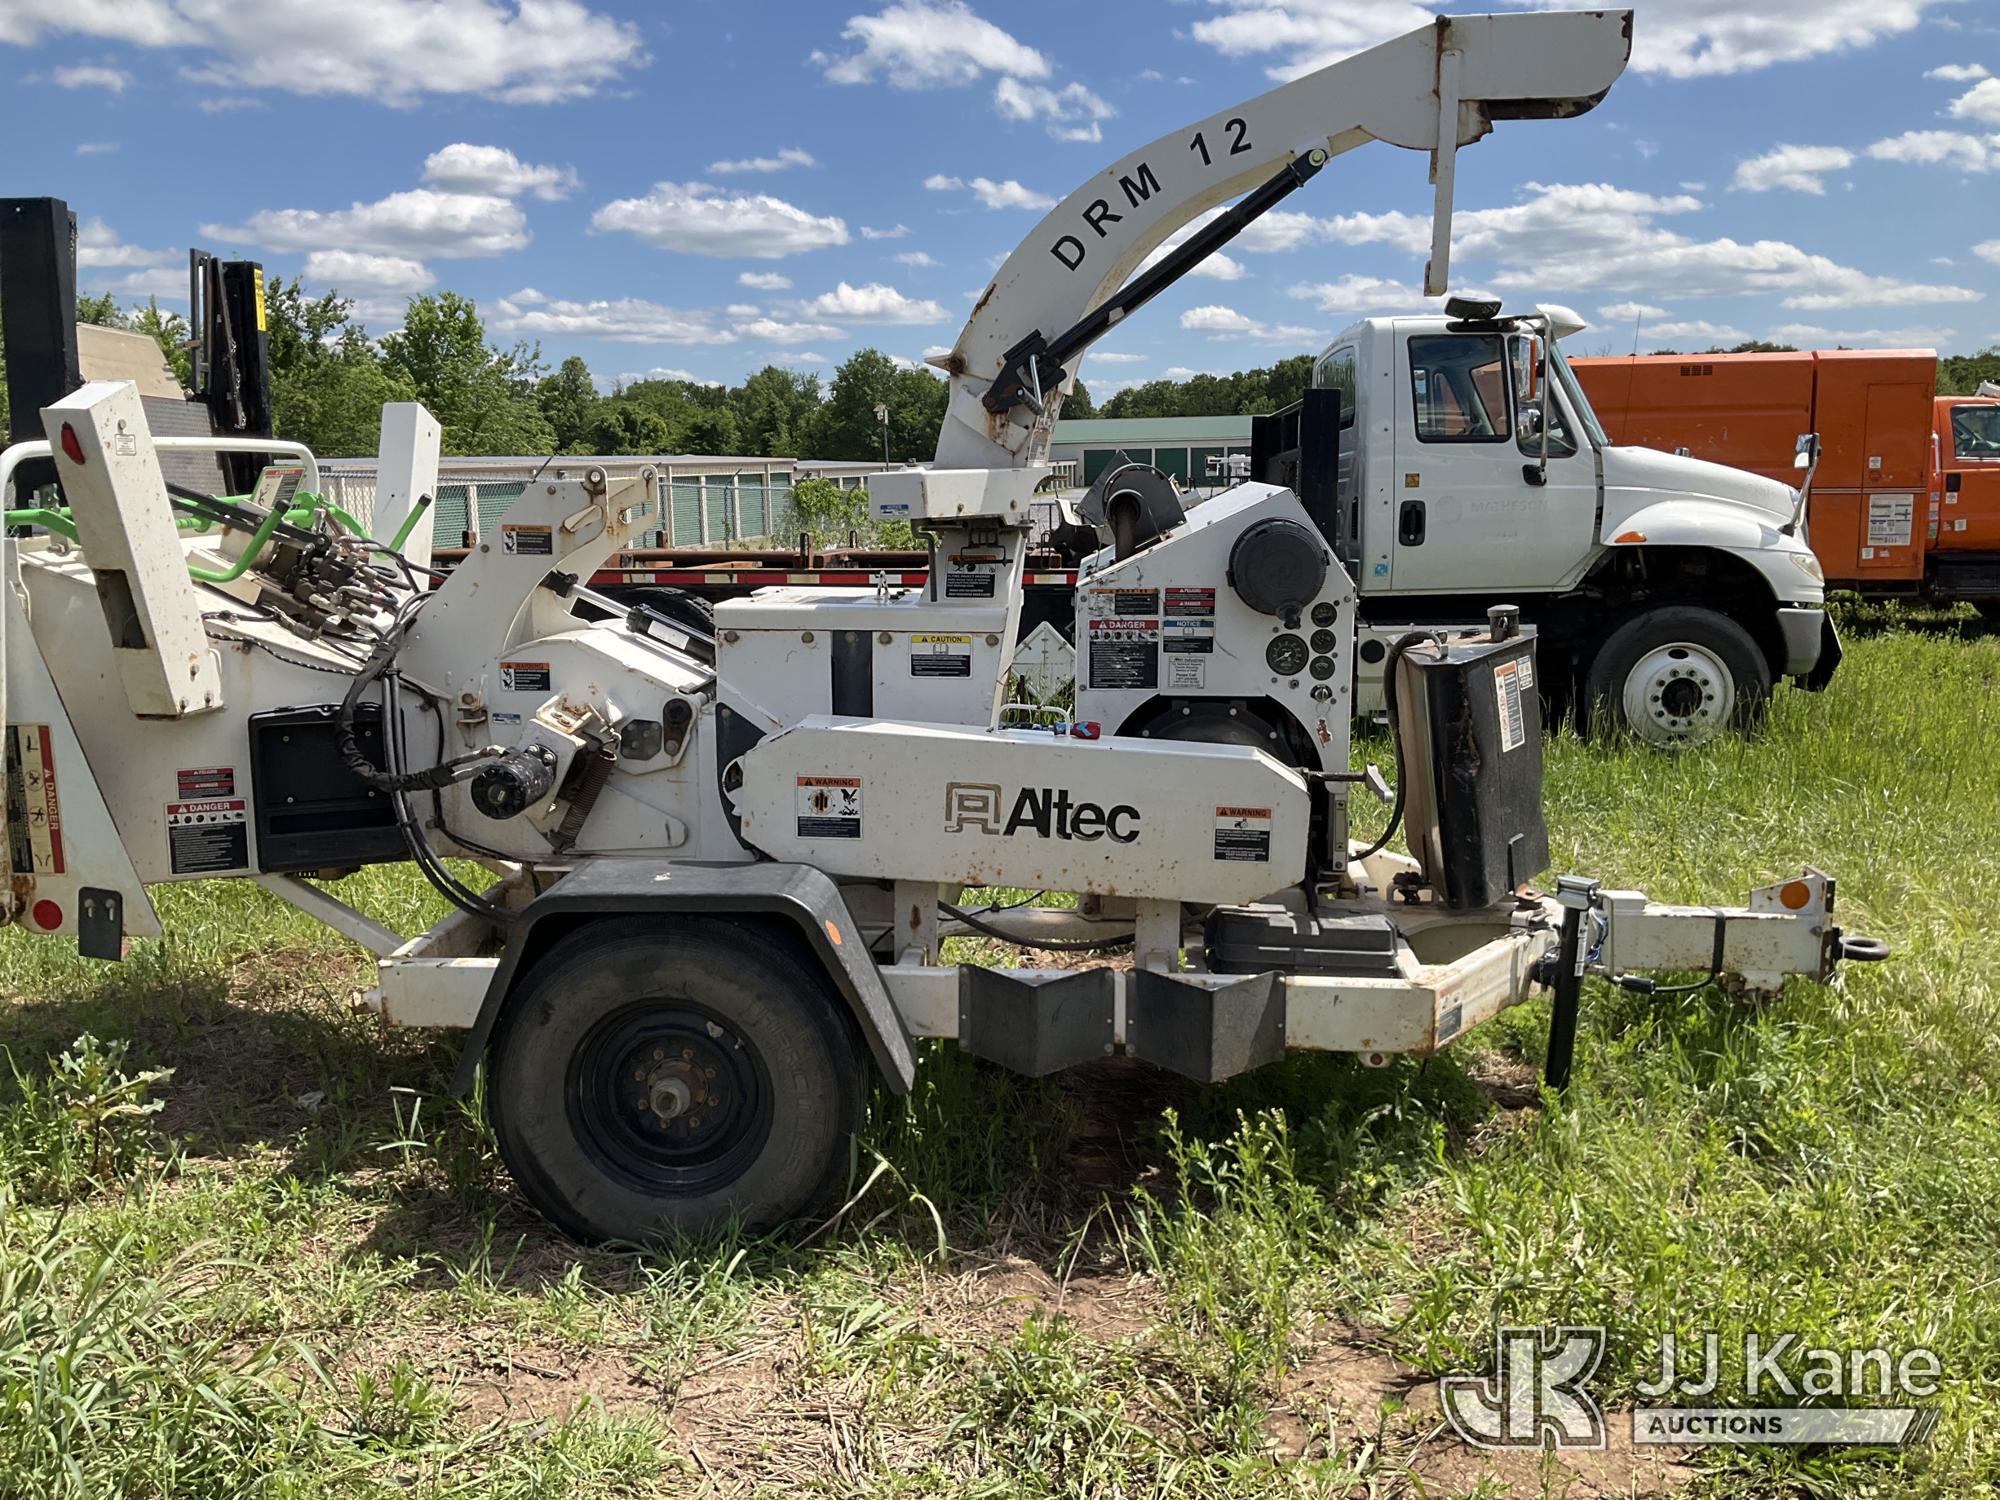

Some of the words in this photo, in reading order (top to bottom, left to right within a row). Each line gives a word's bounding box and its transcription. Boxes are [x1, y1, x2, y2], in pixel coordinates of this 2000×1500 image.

[1050, 162, 1161, 272] DRM
[1190, 118, 1252, 167] 12
[1109, 621, 1146, 629] DANGER
[45, 782, 59, 831] DANGER
[189, 802, 230, 813] DANGER
[1002, 787, 1141, 844] Altec
[1230, 808, 1267, 817] WARNING
